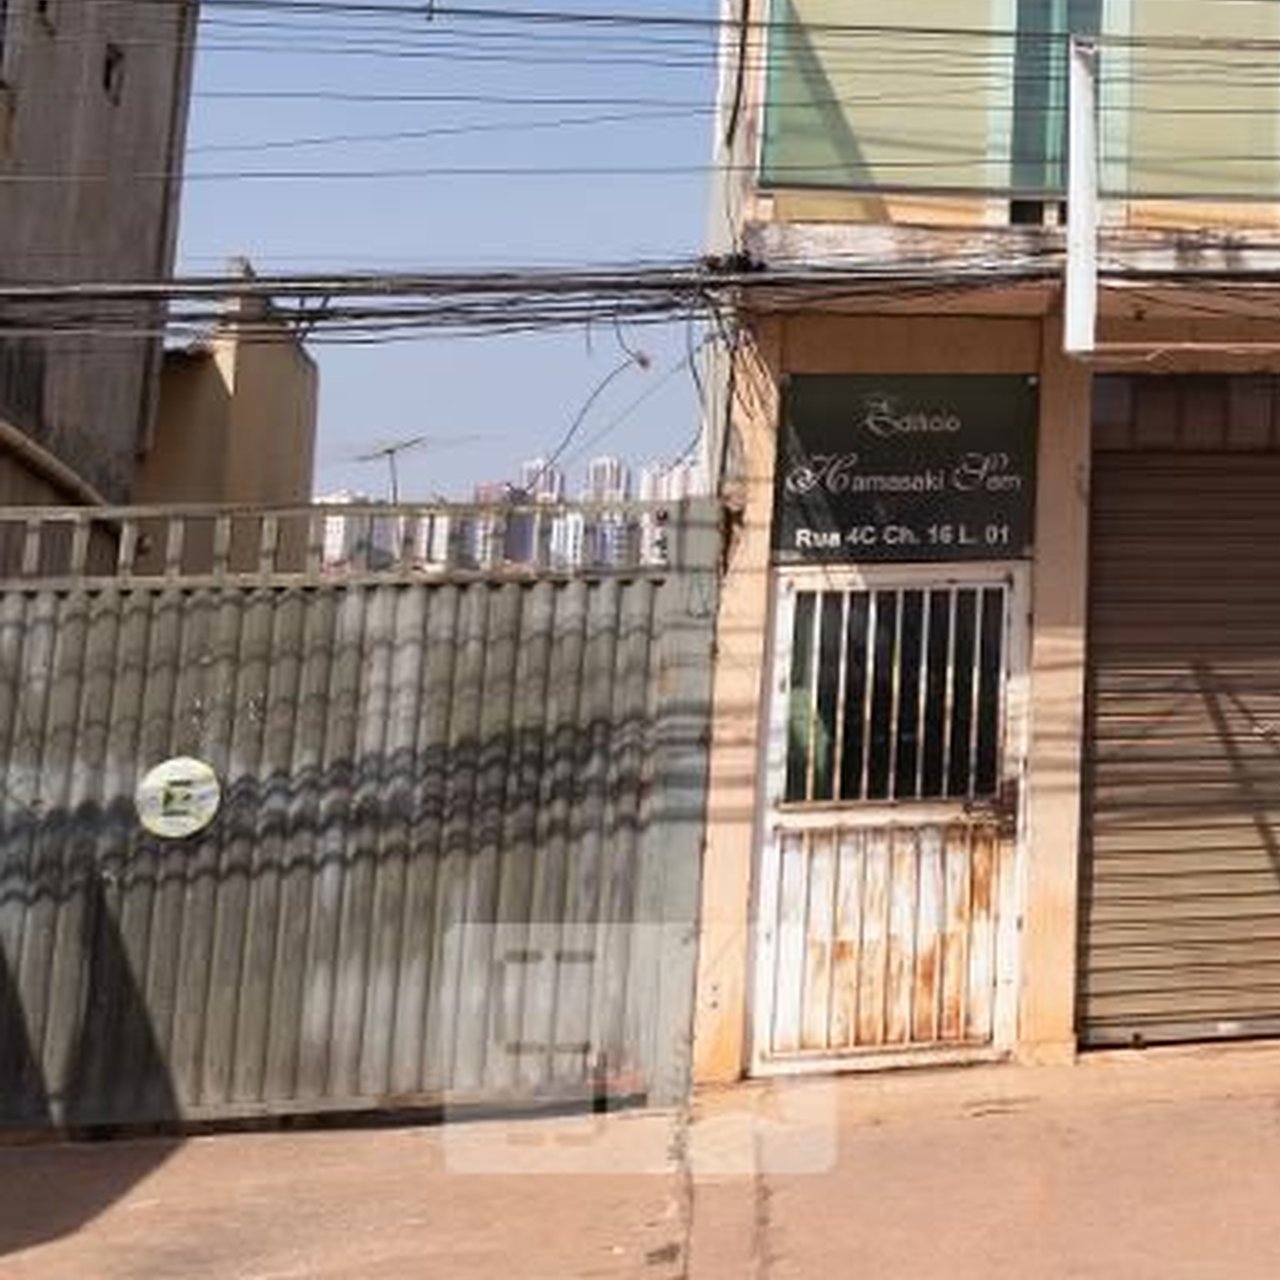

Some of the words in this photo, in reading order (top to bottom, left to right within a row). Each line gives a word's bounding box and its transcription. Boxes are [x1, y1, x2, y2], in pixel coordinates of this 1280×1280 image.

[795, 528, 841, 548] Rua
[845, 526, 877, 545] 4C
[928, 524, 953, 544] 16
[985, 524, 1009, 544] 01
